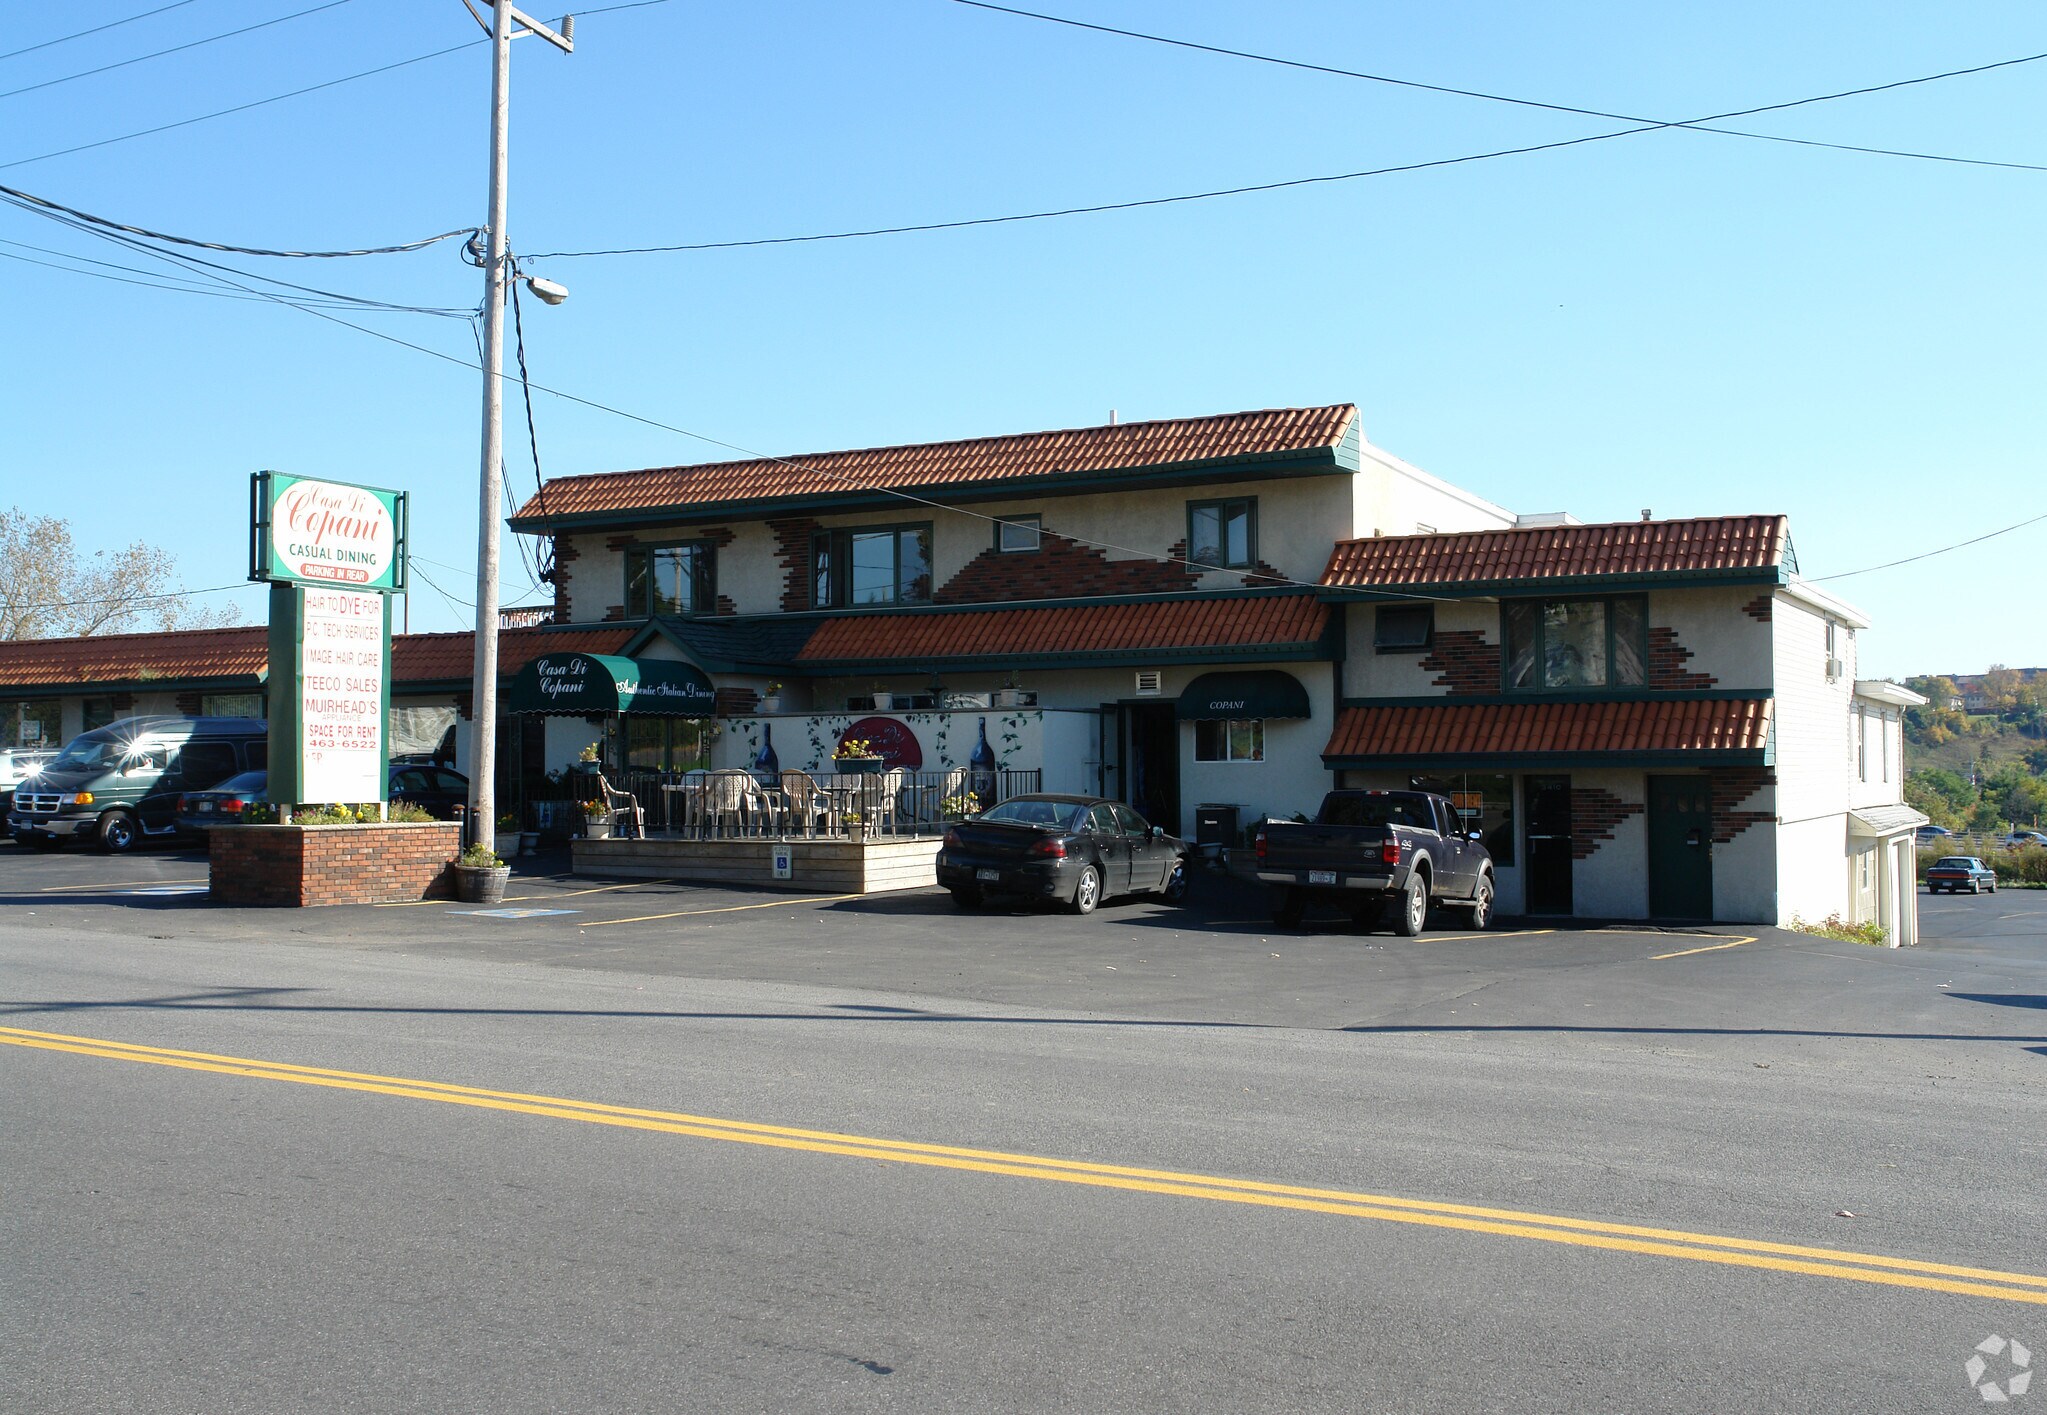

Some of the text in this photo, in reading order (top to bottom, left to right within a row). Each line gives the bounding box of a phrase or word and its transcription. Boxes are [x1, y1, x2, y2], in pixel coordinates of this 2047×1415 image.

[311, 484, 366, 513] Casa Di
[287, 490, 382, 545] Copani
[289, 543, 377, 565] CASUAL DINING
[305, 564, 365, 581] PARKING IN REAR
[306, 596, 379, 615] HAIR TO DYE FOR
[323, 622, 342, 637] TECH
[345, 624, 379, 640] SERVICES
[306, 648, 378, 667] IMAGE HAIR CARE
[537, 658, 588, 676] Casa Di
[306, 676, 378, 693] TEECO SALES
[539, 676, 585, 699] Copani
[615, 678, 716, 703] Authentic Italian Dining
[305, 698, 377, 715] MUIRHEAD'S
[1209, 700, 1244, 710] COPANI
[322, 713, 361, 722] APPLIANCE
[309, 724, 376, 738] SPACE FOR RENT
[309, 739, 376, 749] 463-6522
